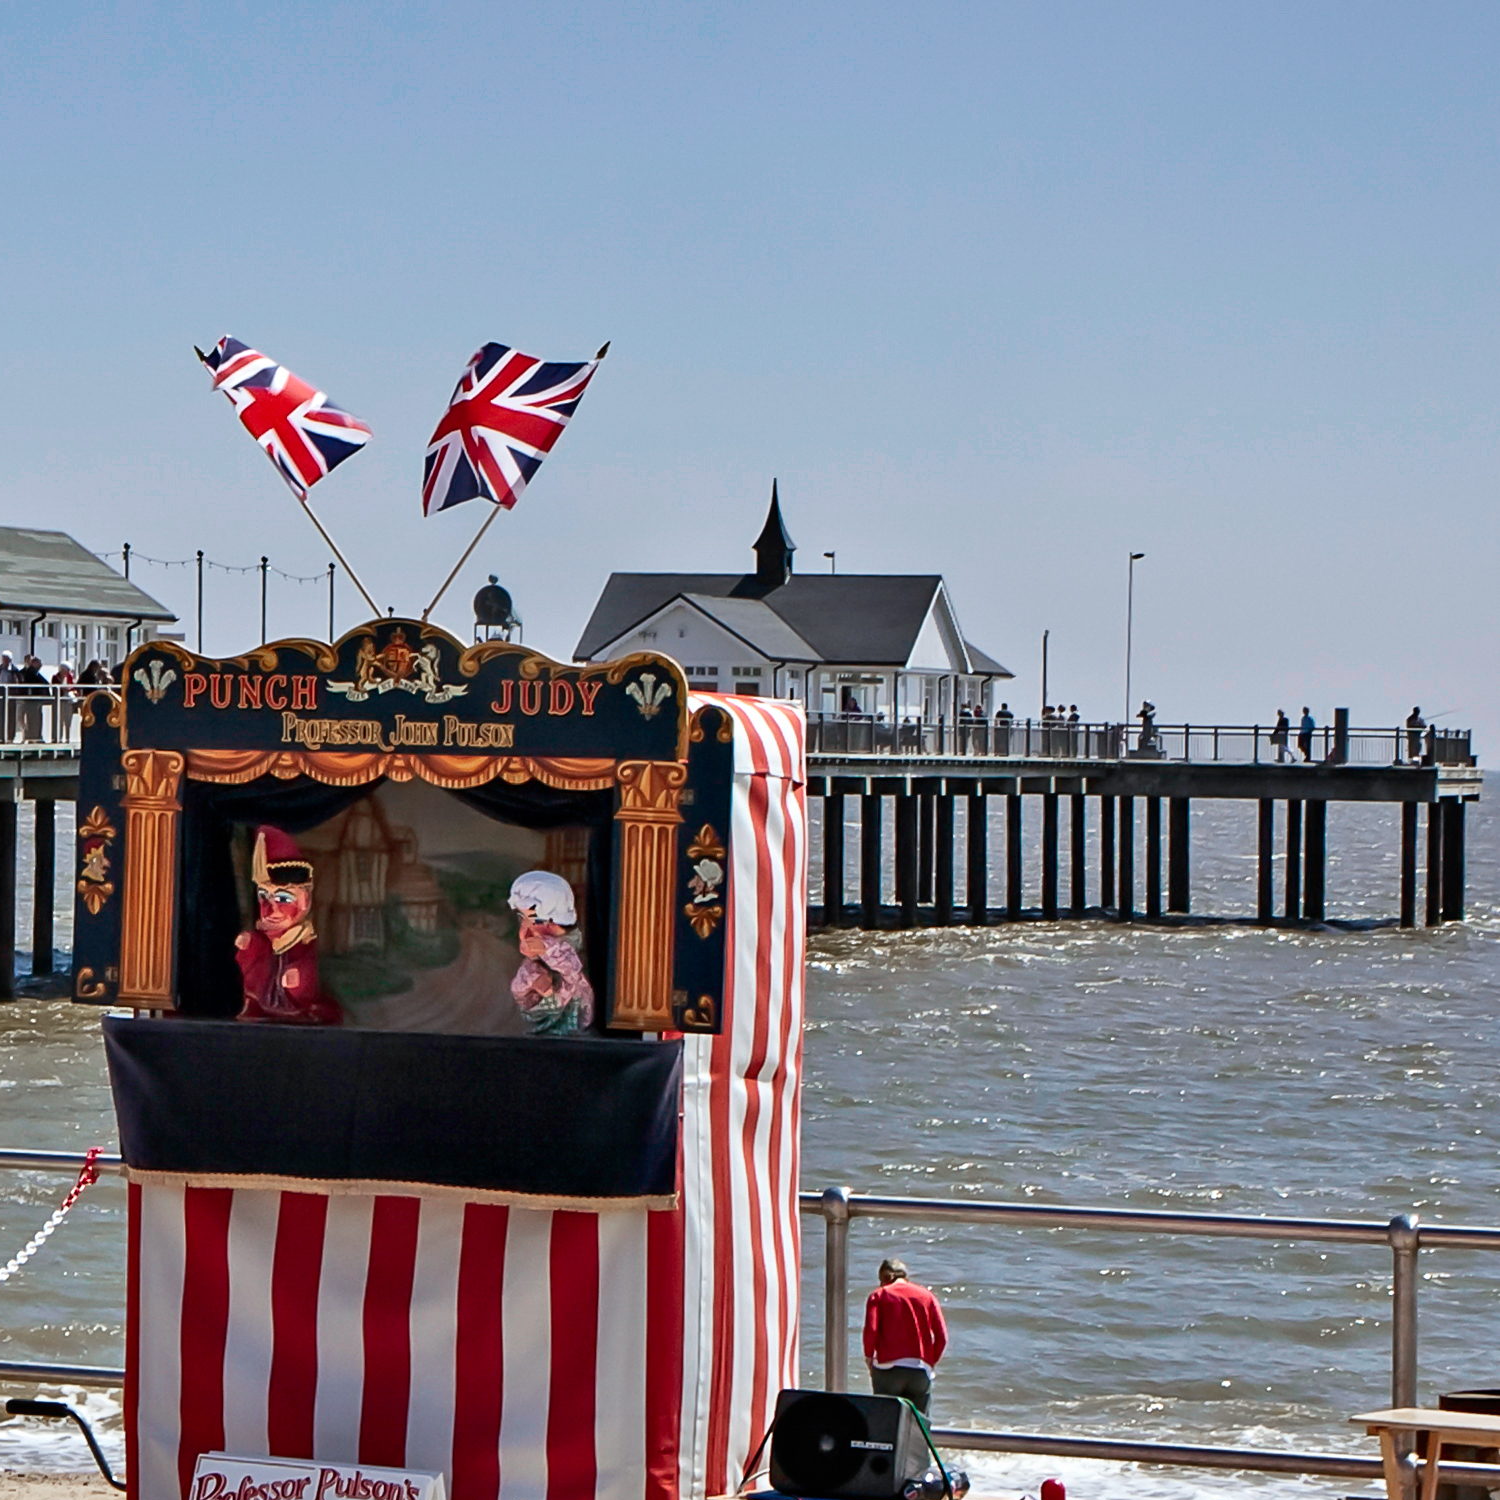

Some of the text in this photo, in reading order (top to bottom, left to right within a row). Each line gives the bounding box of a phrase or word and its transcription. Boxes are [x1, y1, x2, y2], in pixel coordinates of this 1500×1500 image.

[183, 673, 317, 710] PUNCH
[492, 679, 603, 716] JUDY
[281, 712, 514, 750] PROFESSOR JOHN PULSON
